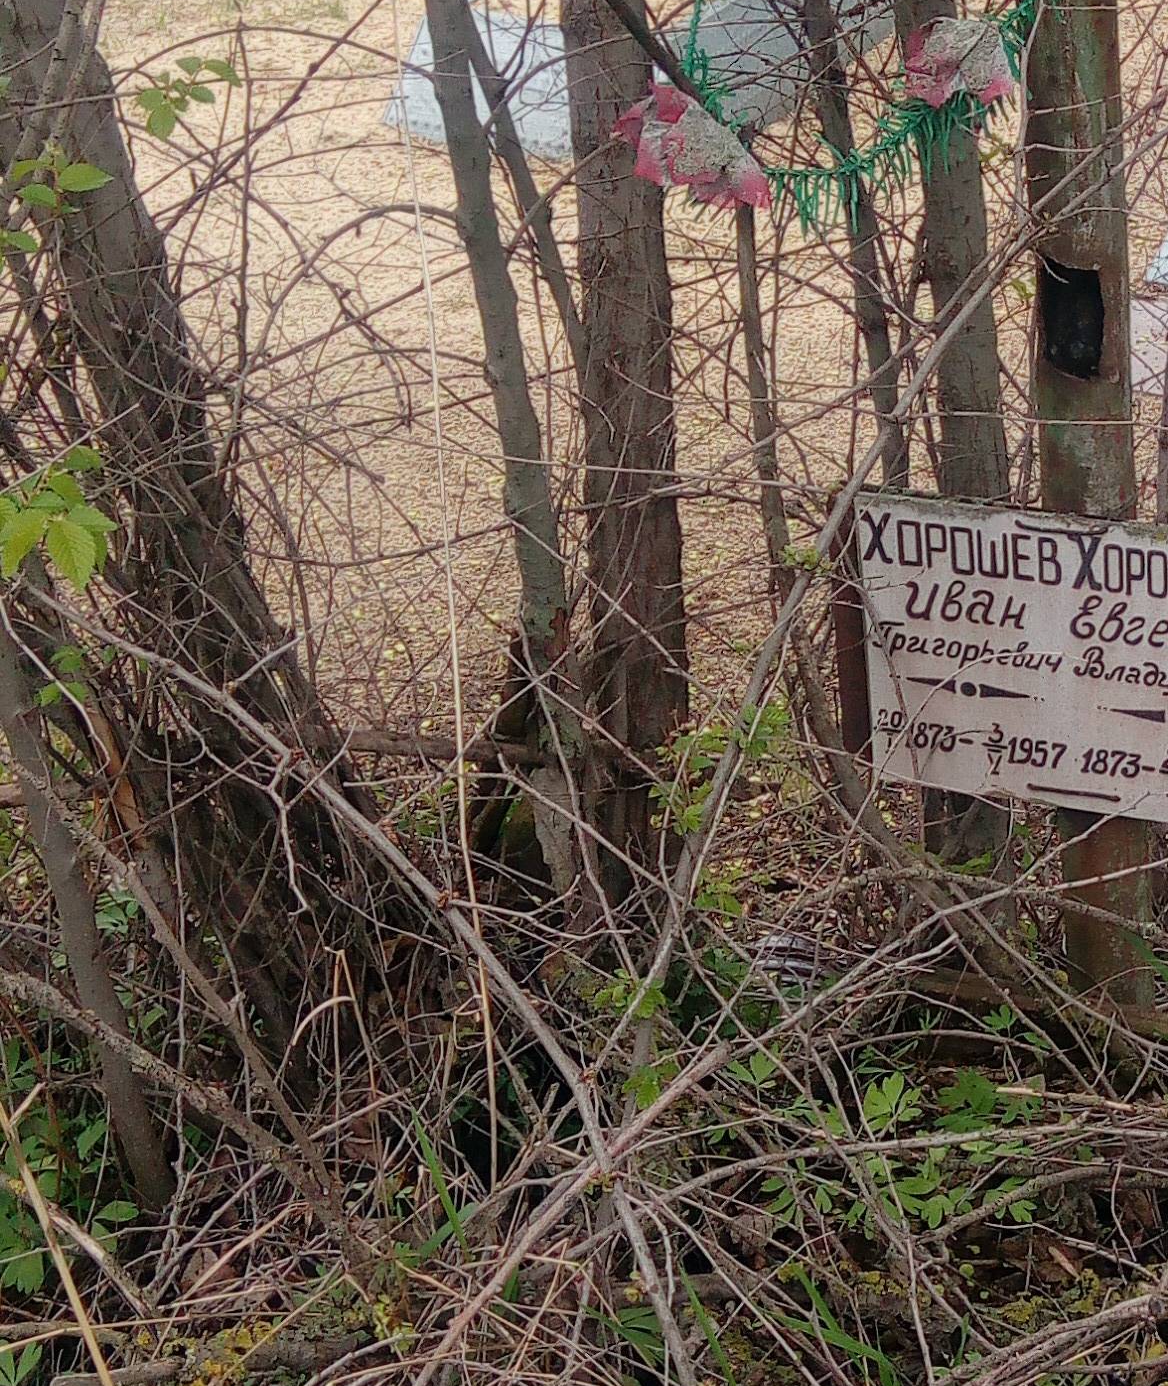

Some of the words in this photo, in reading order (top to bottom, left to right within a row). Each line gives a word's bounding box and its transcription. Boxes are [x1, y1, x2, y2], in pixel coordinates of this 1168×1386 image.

[861, 510, 1062, 586] ХОРОШЕВ
[905, 580, 1026, 629] Иван
[872, 621, 1064, 672] Григорьевич
[1007, 737, 1067, 769] 1957
